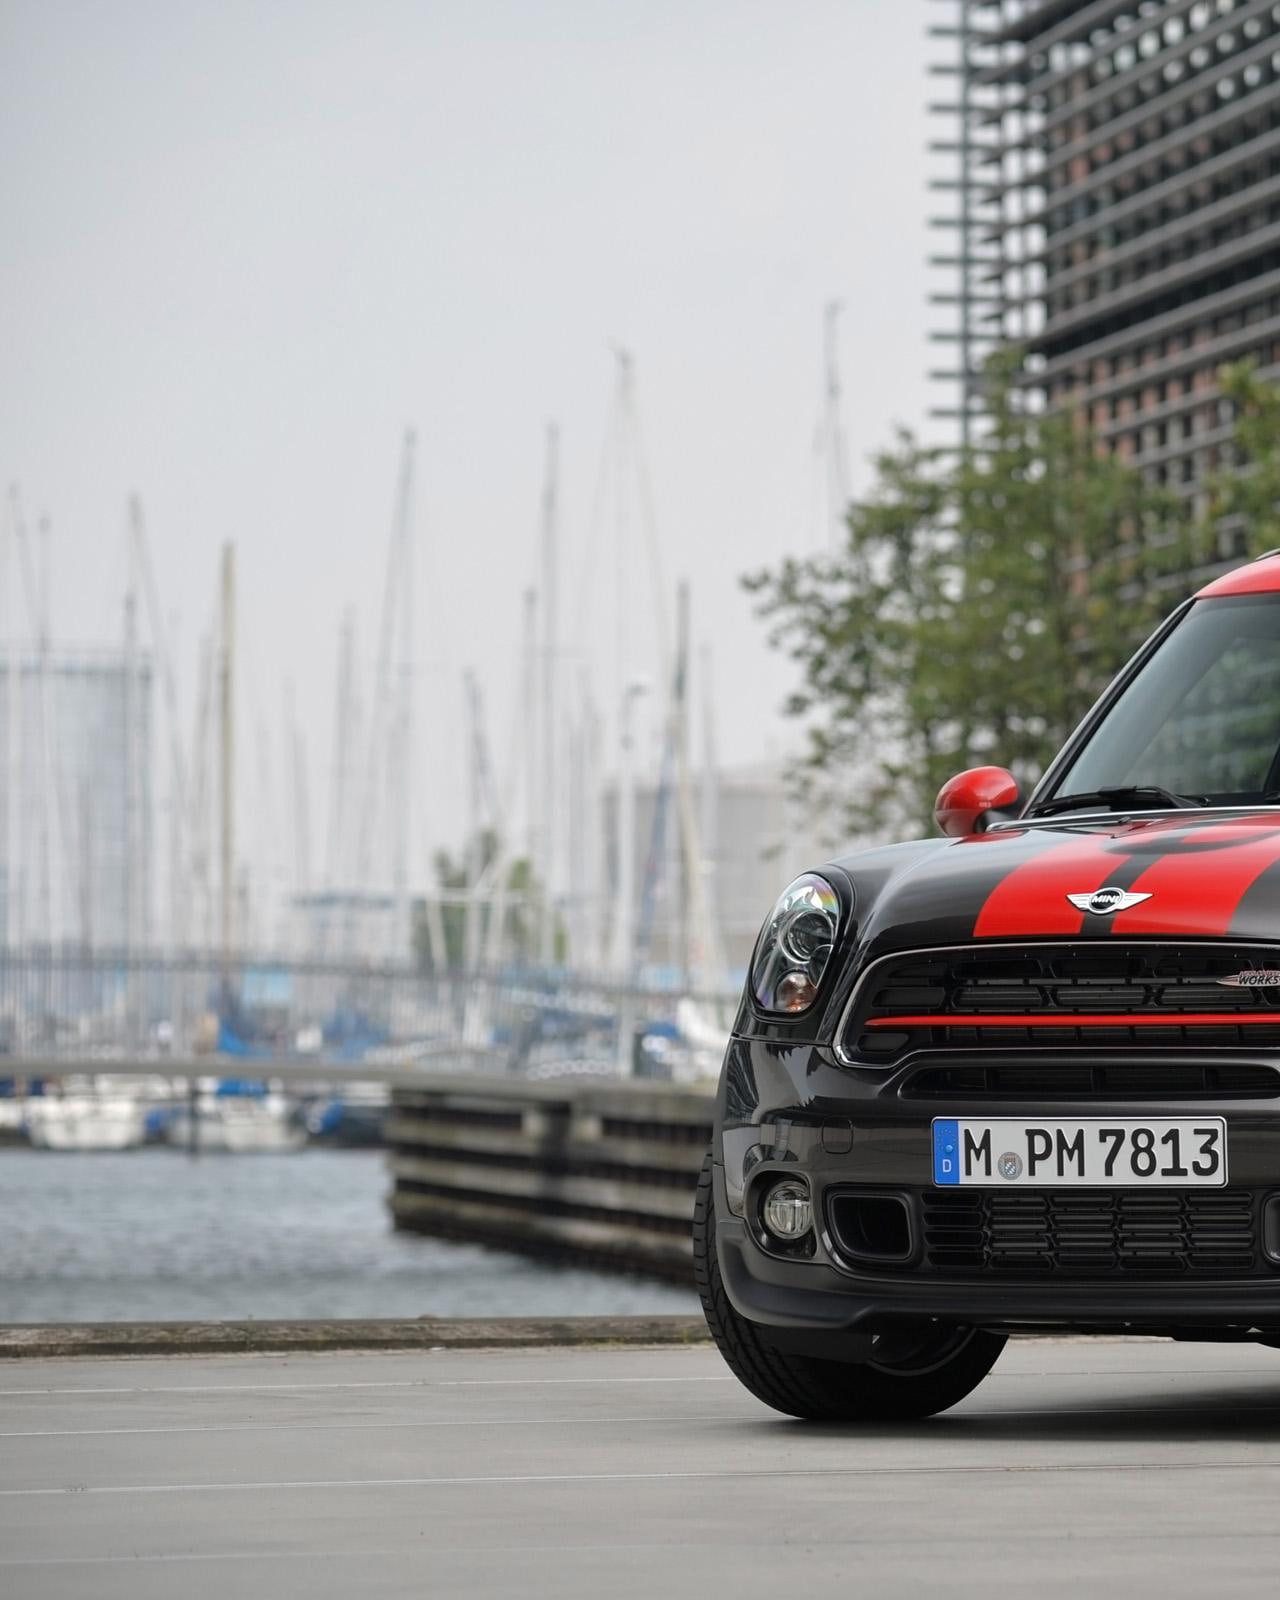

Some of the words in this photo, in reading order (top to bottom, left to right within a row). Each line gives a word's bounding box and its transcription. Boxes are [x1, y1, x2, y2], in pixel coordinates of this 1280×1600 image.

[1091, 894, 1121, 904] MINI
[1238, 975, 1280, 985] WORKS
[964, 1128, 992, 1177] M
[1025, 1128, 1086, 1177] PM
[1099, 1128, 1220, 1177] 7813
[942, 1159, 952, 1173] D
